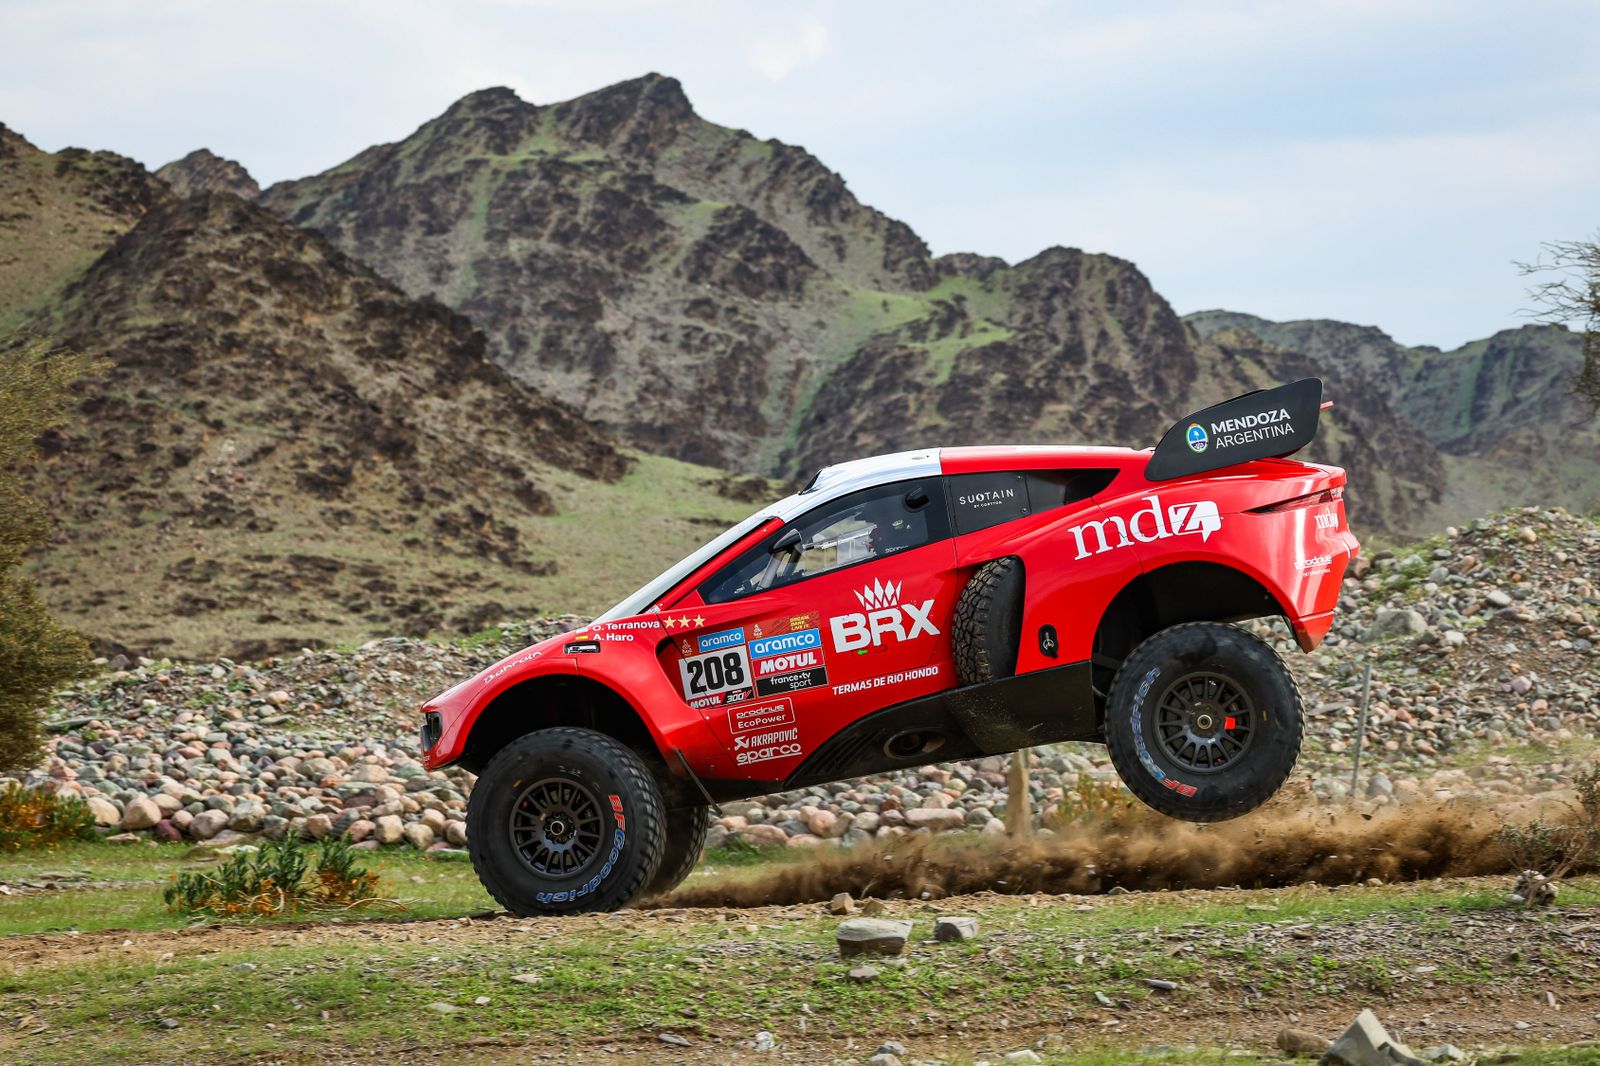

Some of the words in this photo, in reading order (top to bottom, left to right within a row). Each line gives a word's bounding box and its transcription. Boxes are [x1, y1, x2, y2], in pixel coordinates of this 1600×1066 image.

[1210, 408, 1291, 435] MENDOZA
[1216, 422, 1295, 449] ARGENTINA
[1068, 495, 1222, 560] mdz
[606, 620, 660, 631] Terranova
[829, 599, 941, 653] BRX
[592, 633, 604, 641] A.
[606, 632, 634, 642] Haro
[701, 632, 742, 647] aramco
[754, 633, 815, 654] aramco
[686, 652, 745, 695] 208
[759, 651, 817, 675] MOTUL
[789, 679, 812, 691] sport
[832, 679, 872, 696] TERMAS
[873, 676, 886, 688] DE
[904, 666, 939, 681] HONDO
[690, 695, 722, 709] MOTUL
[726, 689, 752, 704] 300V
[737, 714, 786, 729] EcoPower
[736, 743, 802, 765] sparco
